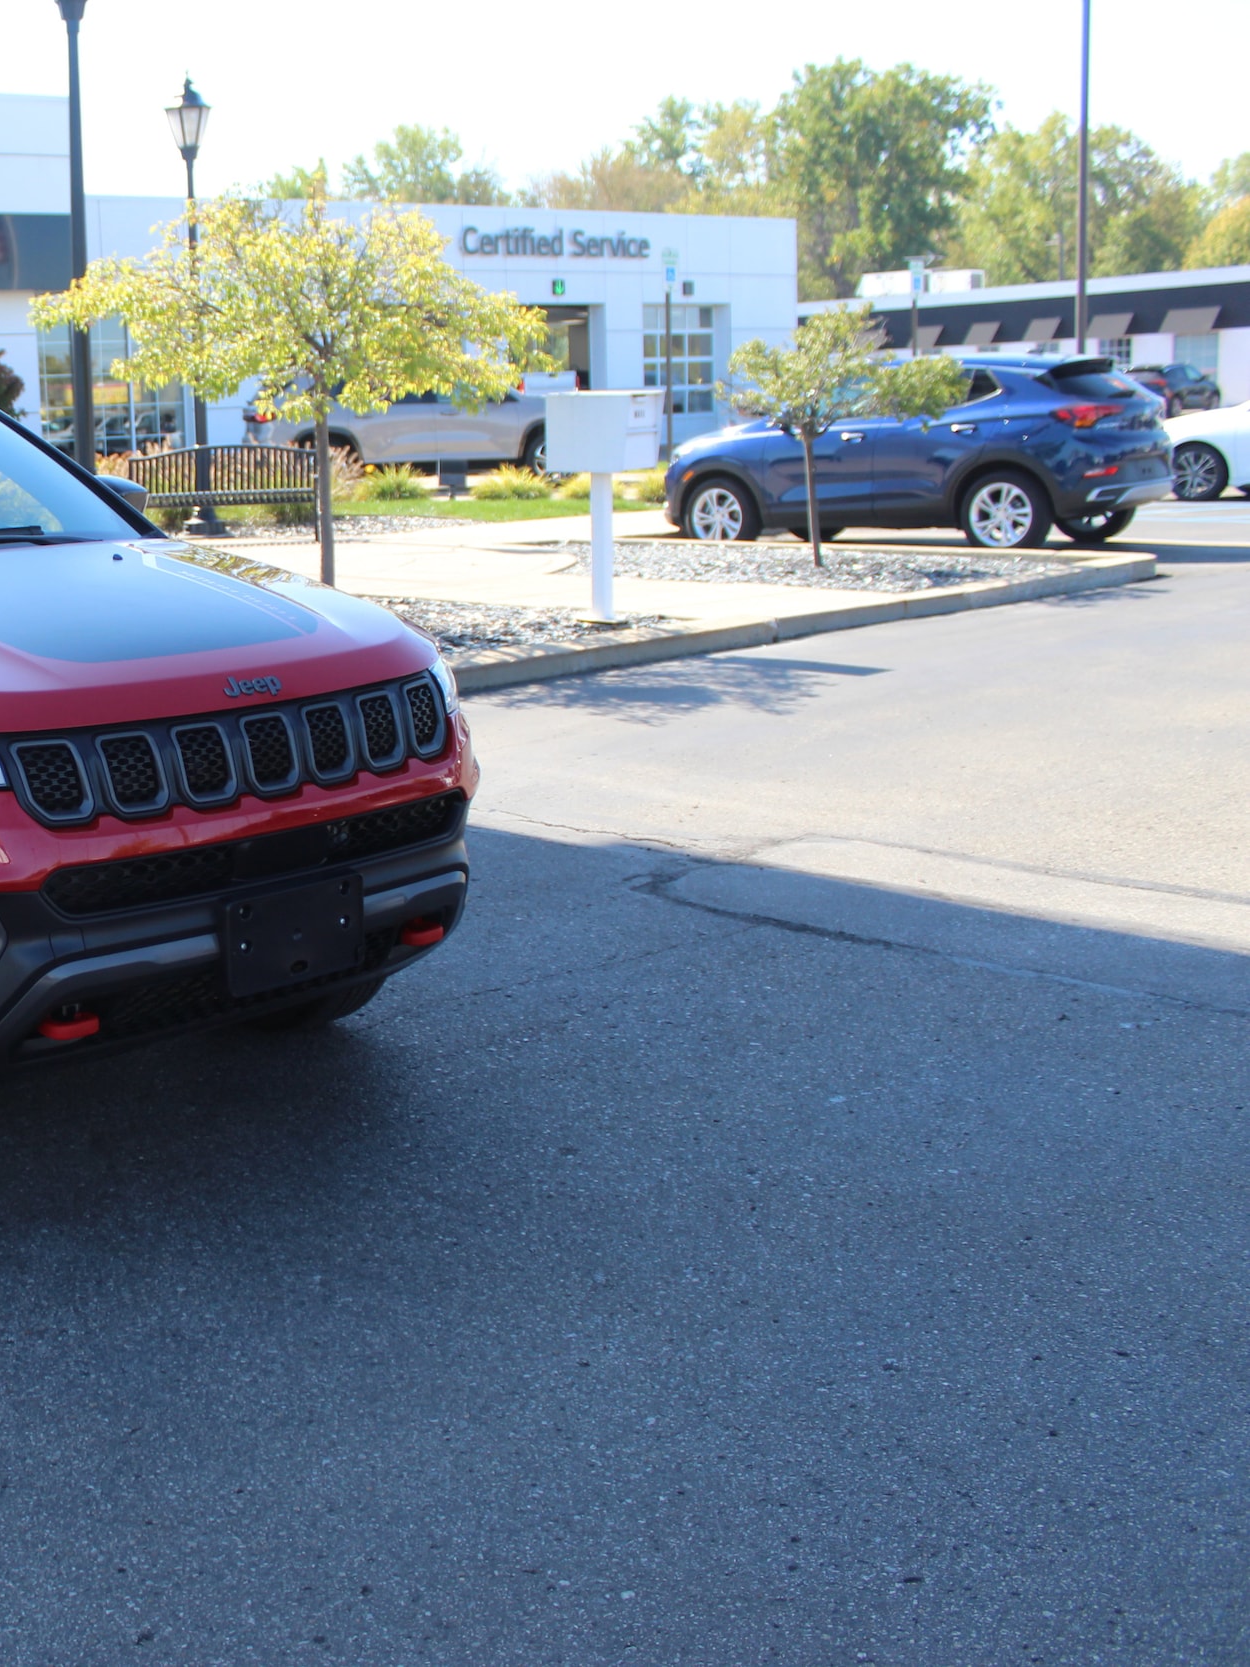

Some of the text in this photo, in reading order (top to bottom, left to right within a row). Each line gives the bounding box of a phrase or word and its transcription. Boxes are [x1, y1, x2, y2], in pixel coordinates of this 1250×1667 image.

[461, 226, 565, 257] Certified
[570, 229, 651, 259] Service
[223, 675, 282, 697] Jeep
